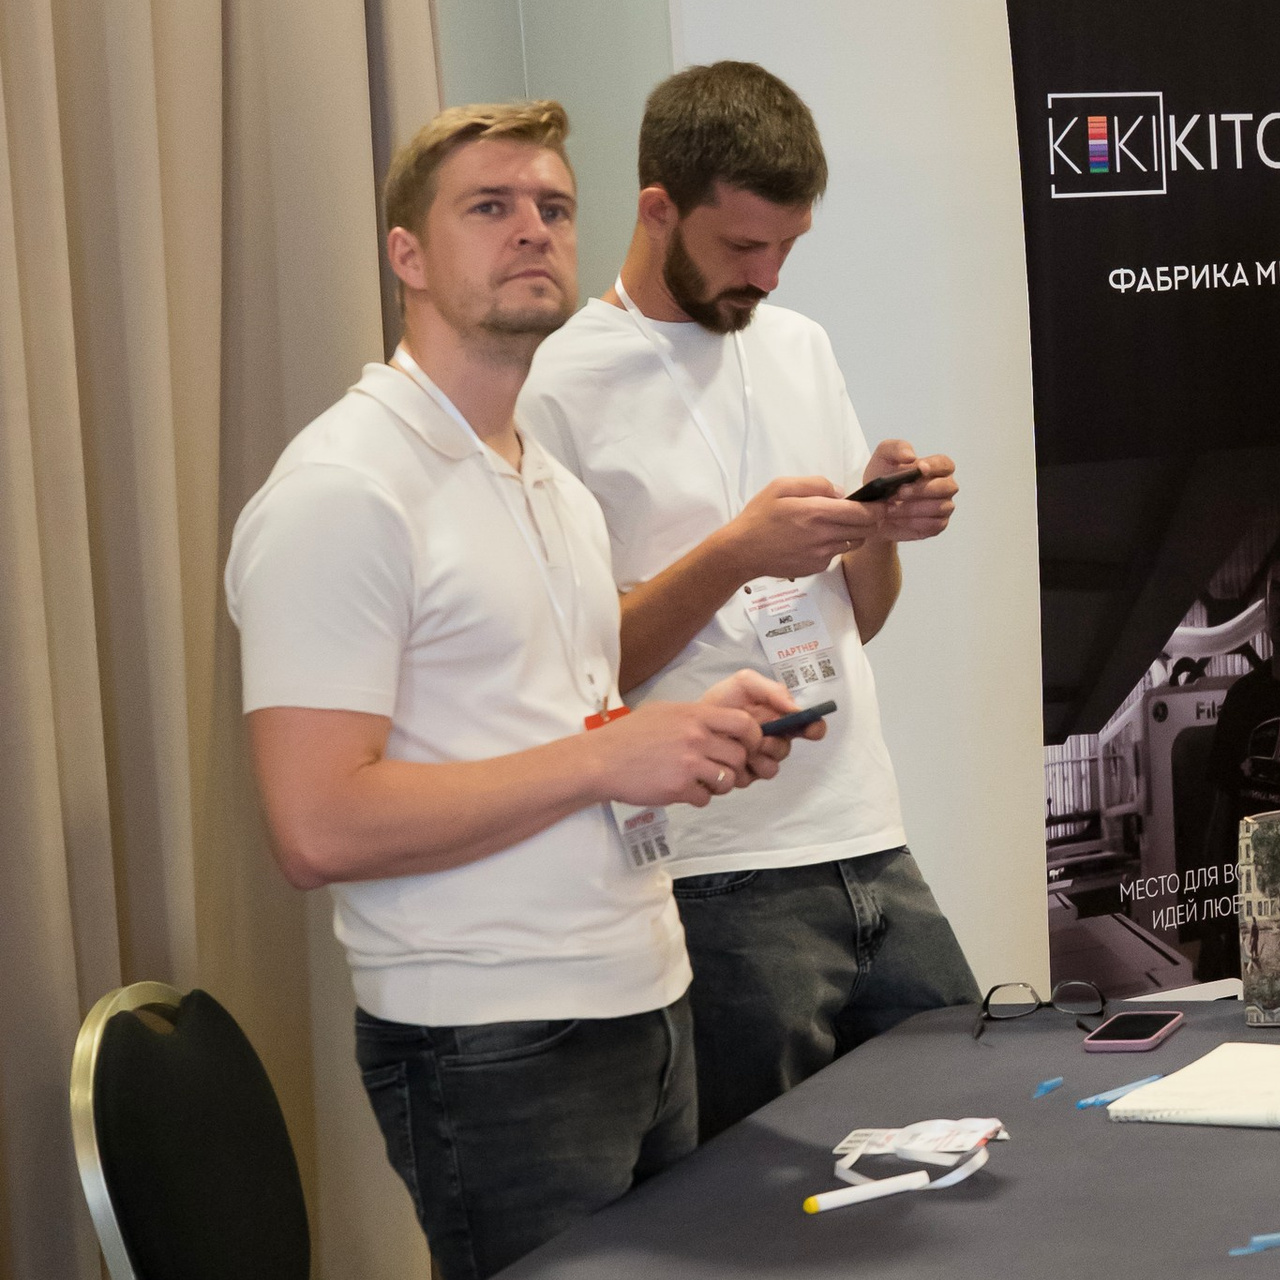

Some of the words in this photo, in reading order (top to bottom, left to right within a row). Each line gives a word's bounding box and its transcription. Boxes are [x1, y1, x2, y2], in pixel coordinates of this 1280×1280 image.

[1108, 262, 1250, 293] ФАБРИКА
[777, 640, 820, 659] ПАРТНЕР
[1120, 873, 1180, 902] МЕСТО
[1184, 866, 1219, 895] ДЛЯ
[1152, 898, 1198, 931] ИДЕЙ
